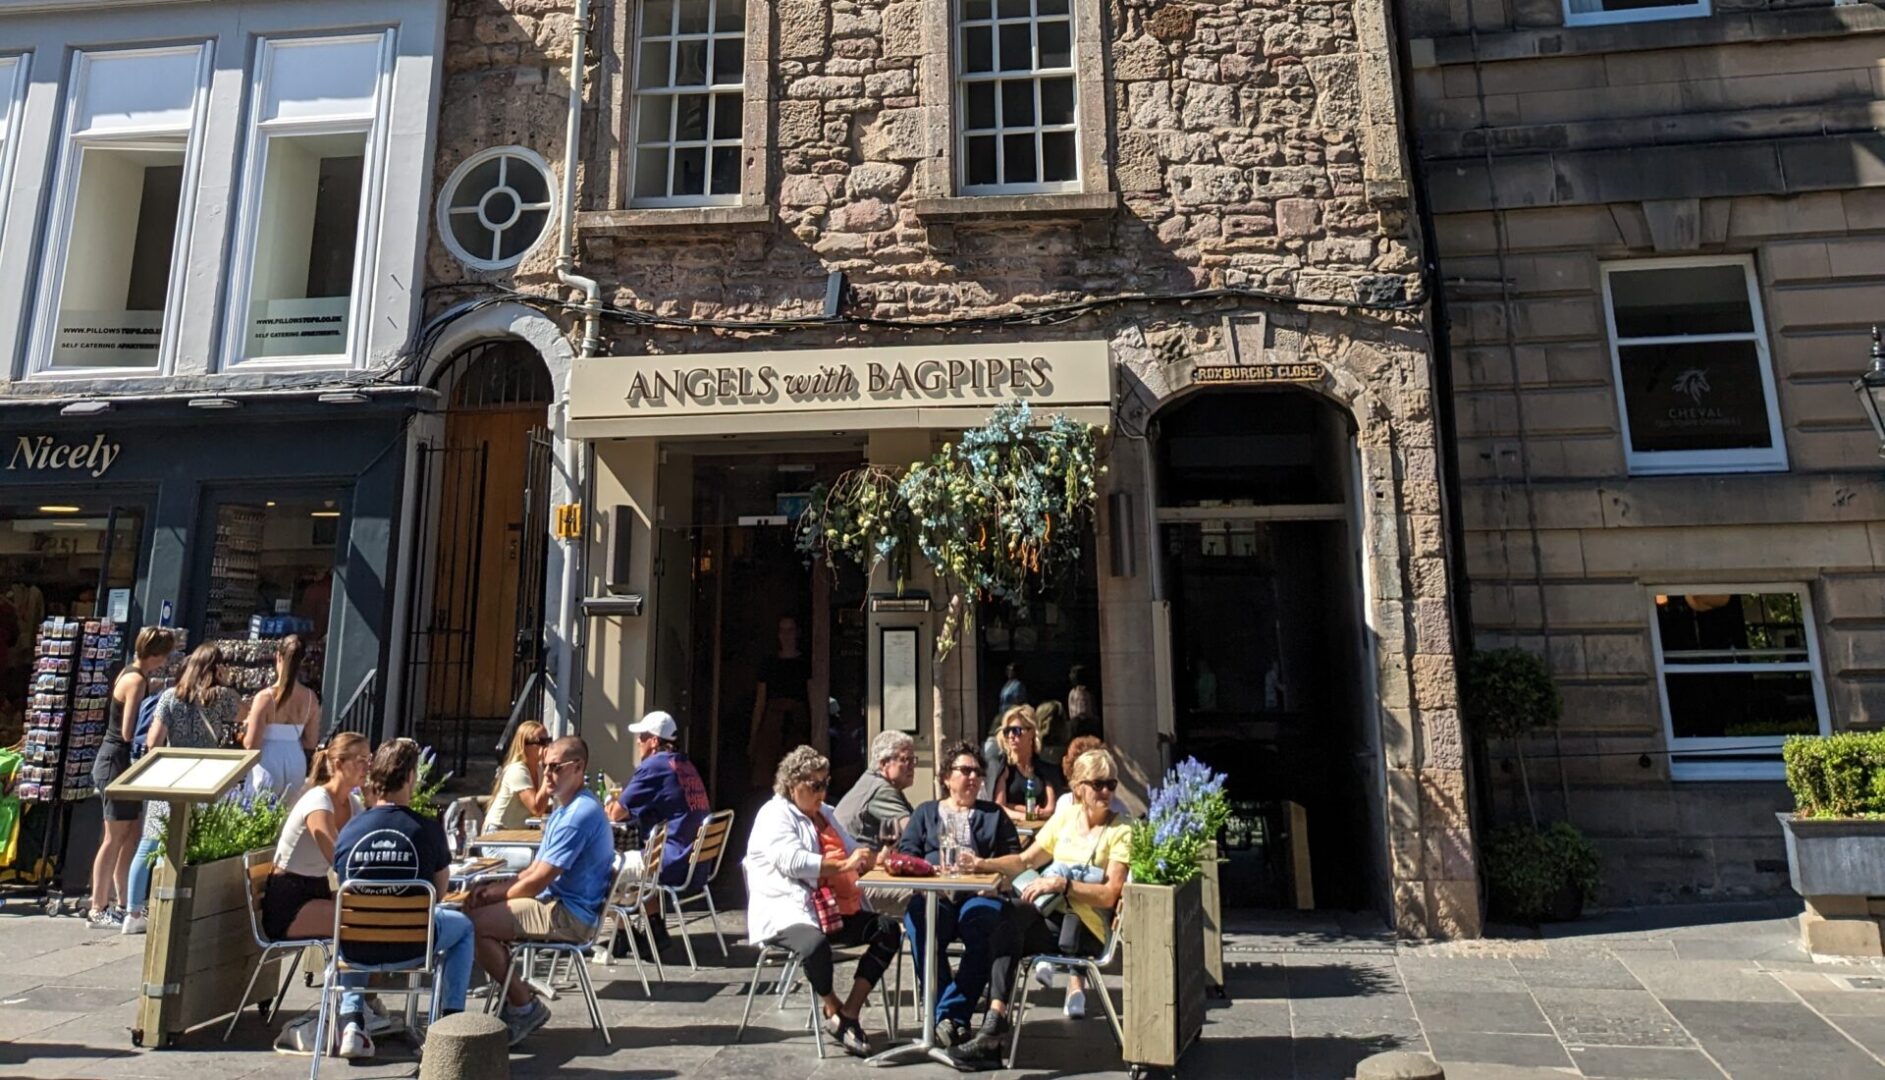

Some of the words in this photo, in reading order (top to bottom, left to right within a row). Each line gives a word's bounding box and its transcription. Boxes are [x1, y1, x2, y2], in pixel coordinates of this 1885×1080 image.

[625, 365, 777, 403] ANGELS
[783, 364, 855, 396] with
[867, 356, 1050, 394] BAGPIPES
[1197, 365, 1273, 380] ROXBURGH'S
[1277, 364, 1317, 378] CLOSE
[1668, 407, 1722, 418] CHEVAL
[5, 433, 120, 478] Nicely
